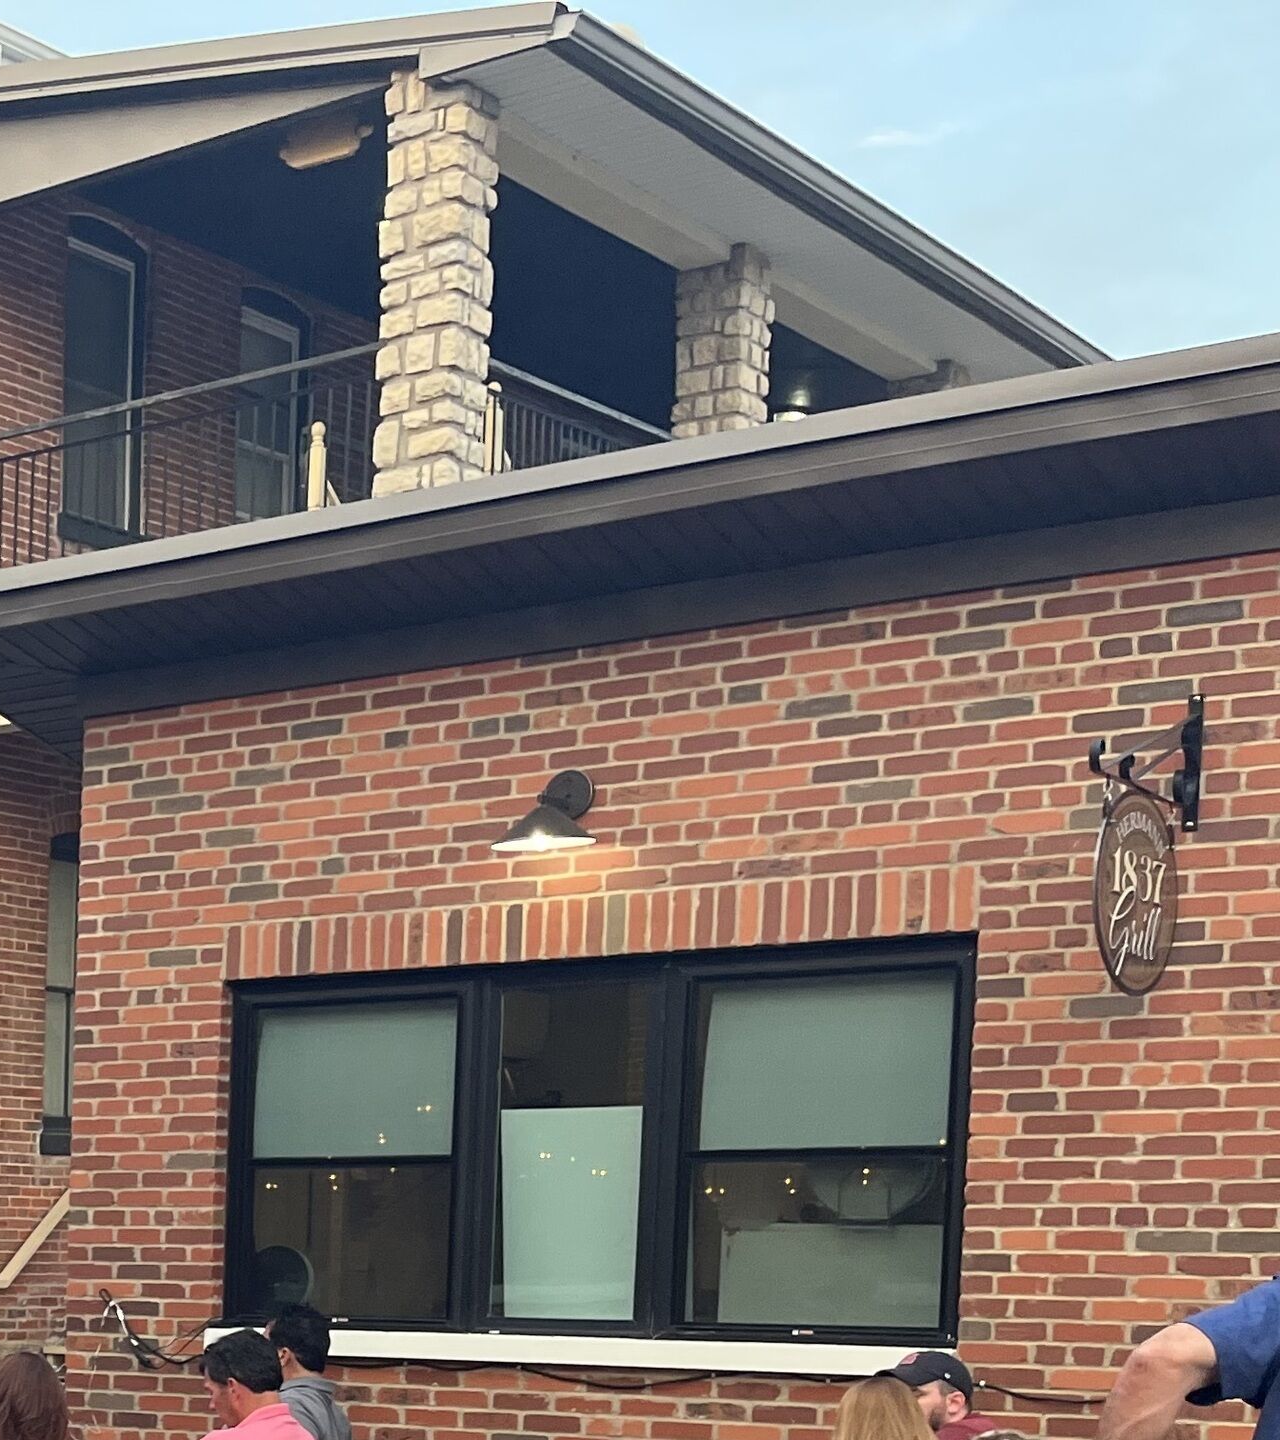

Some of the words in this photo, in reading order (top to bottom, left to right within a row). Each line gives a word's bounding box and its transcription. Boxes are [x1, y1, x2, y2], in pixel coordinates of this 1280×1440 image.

[1115, 811, 1166, 859] HERMANN
[1111, 846, 1167, 904] 1837
[1109, 885, 1162, 976] Grill
